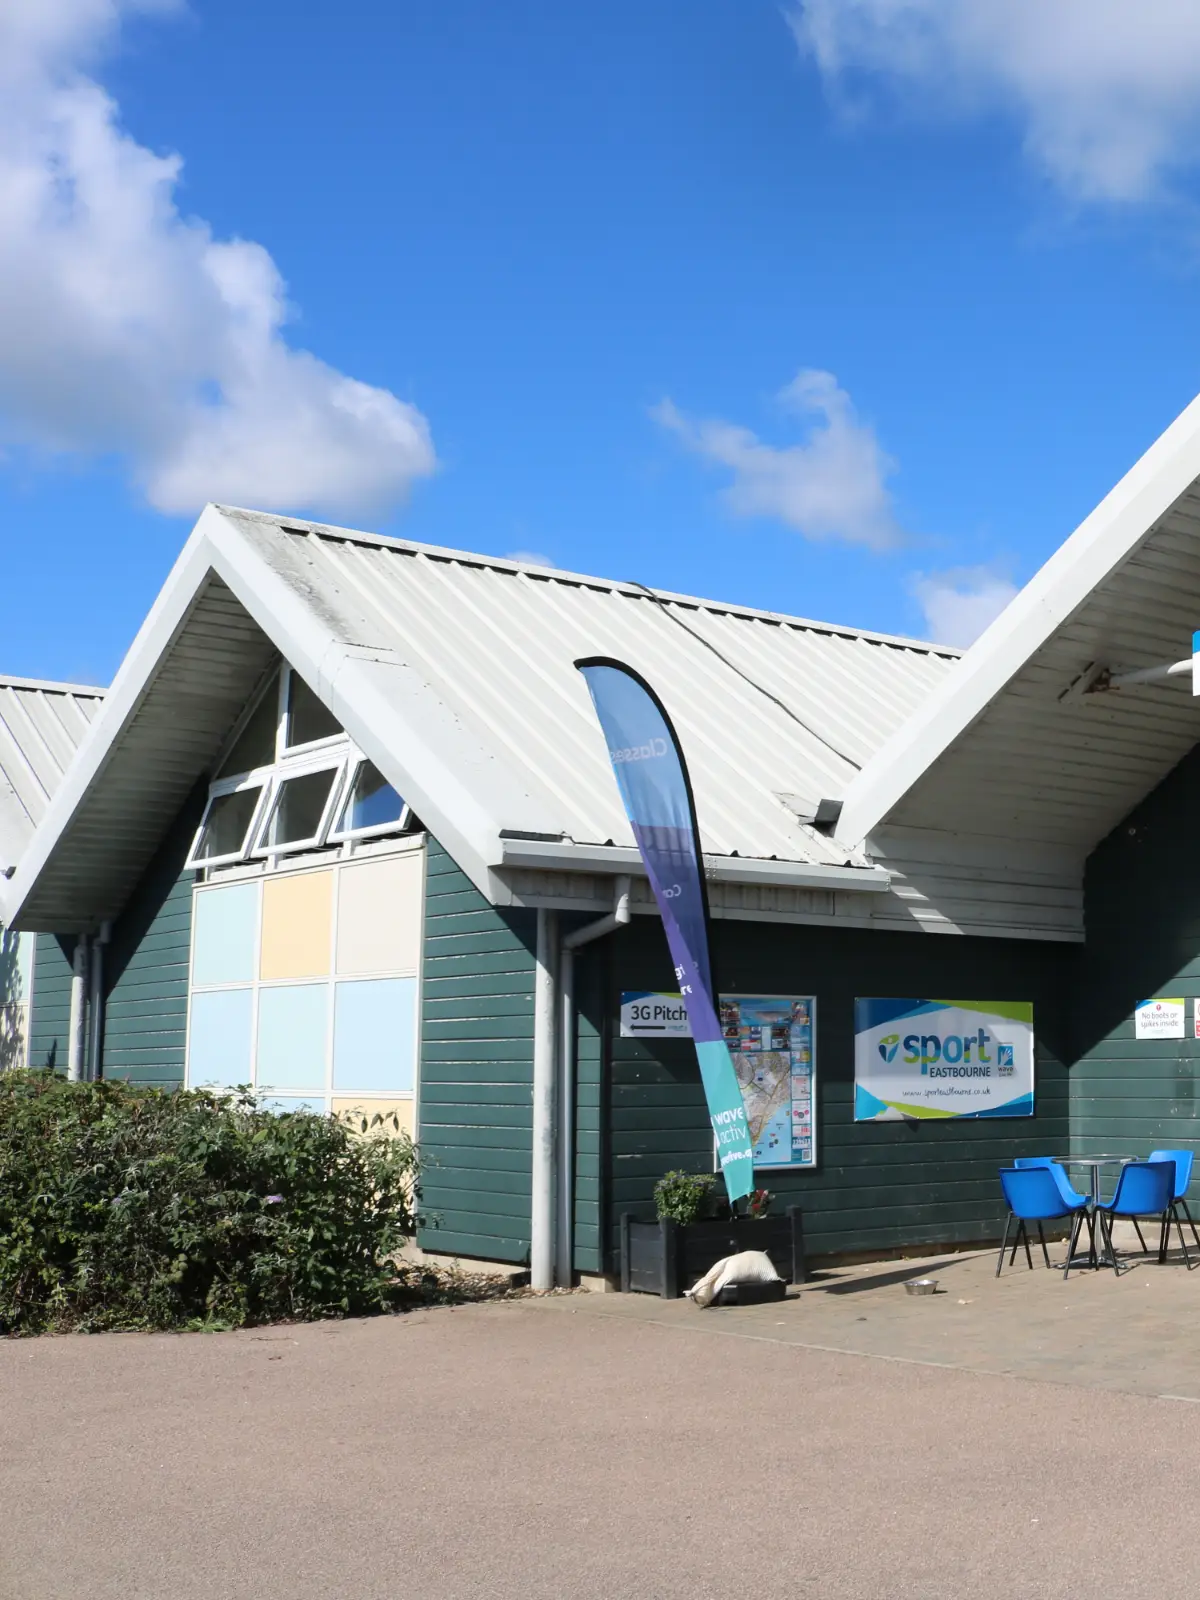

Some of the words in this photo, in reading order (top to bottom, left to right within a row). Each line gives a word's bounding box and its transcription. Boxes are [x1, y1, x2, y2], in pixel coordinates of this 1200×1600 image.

[631, 1005, 651, 1020] 3G
[654, 1005, 688, 1020] Pitch
[1141, 1012, 1151, 1020] No
[903, 1028, 991, 1075] sport
[929, 1066, 992, 1078] EASTBOURNE
[720, 1124, 746, 1144] activ
